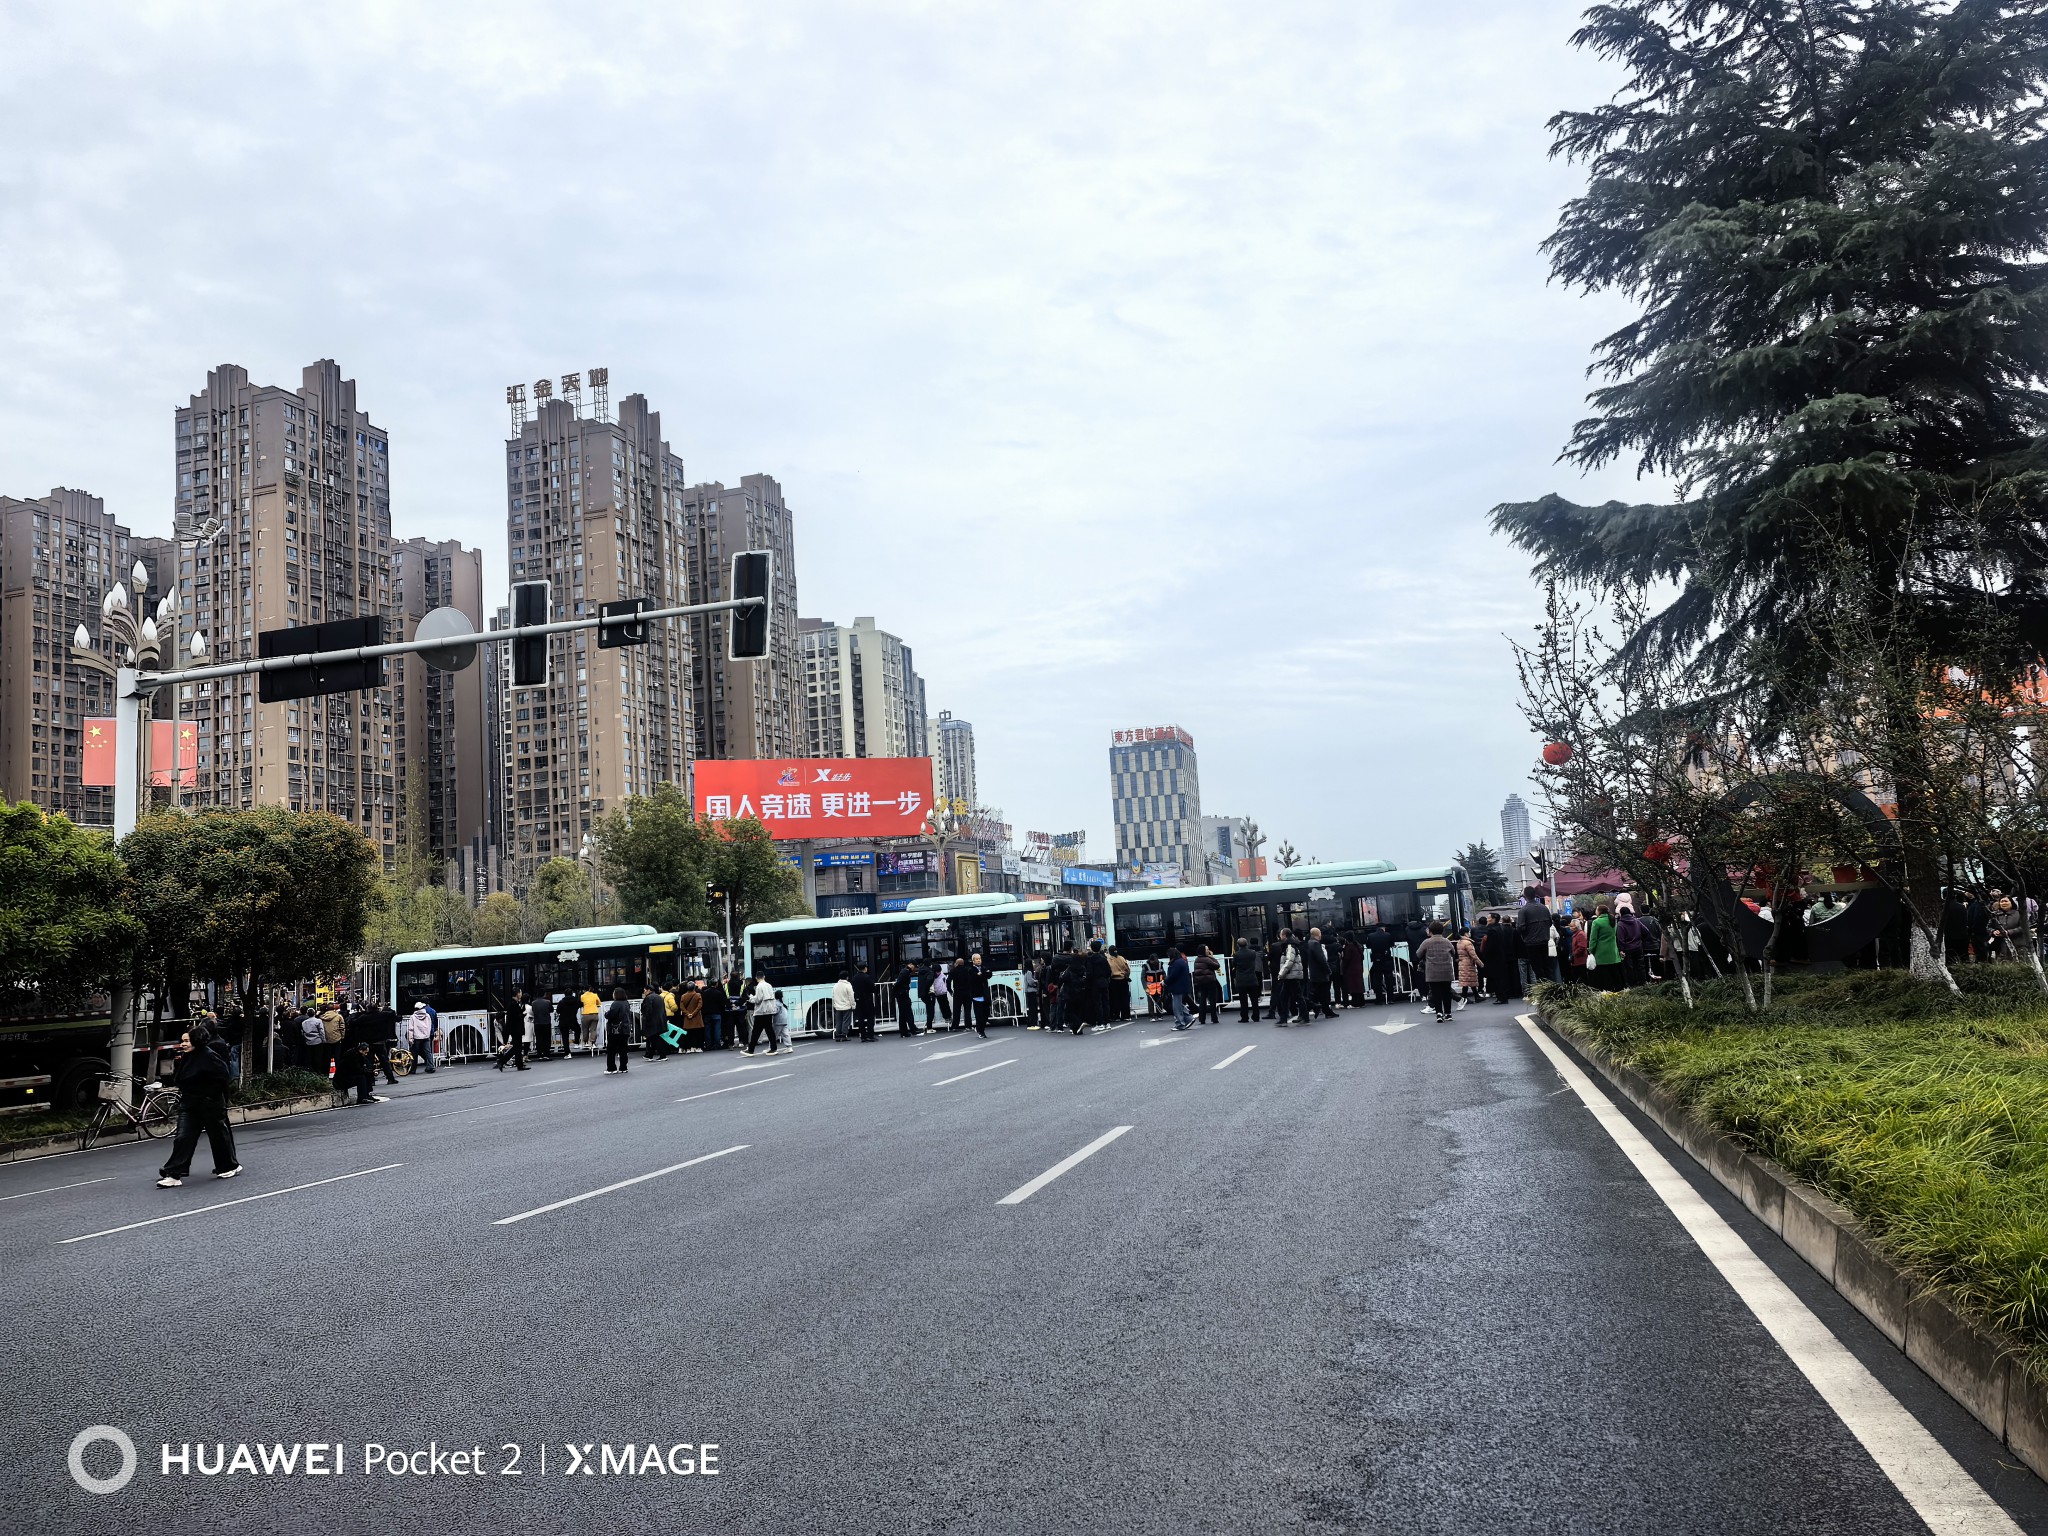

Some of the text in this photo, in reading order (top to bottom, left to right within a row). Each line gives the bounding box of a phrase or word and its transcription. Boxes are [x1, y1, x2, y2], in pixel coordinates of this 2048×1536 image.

[706, 791, 921, 821] 国人竞速 更进一步
